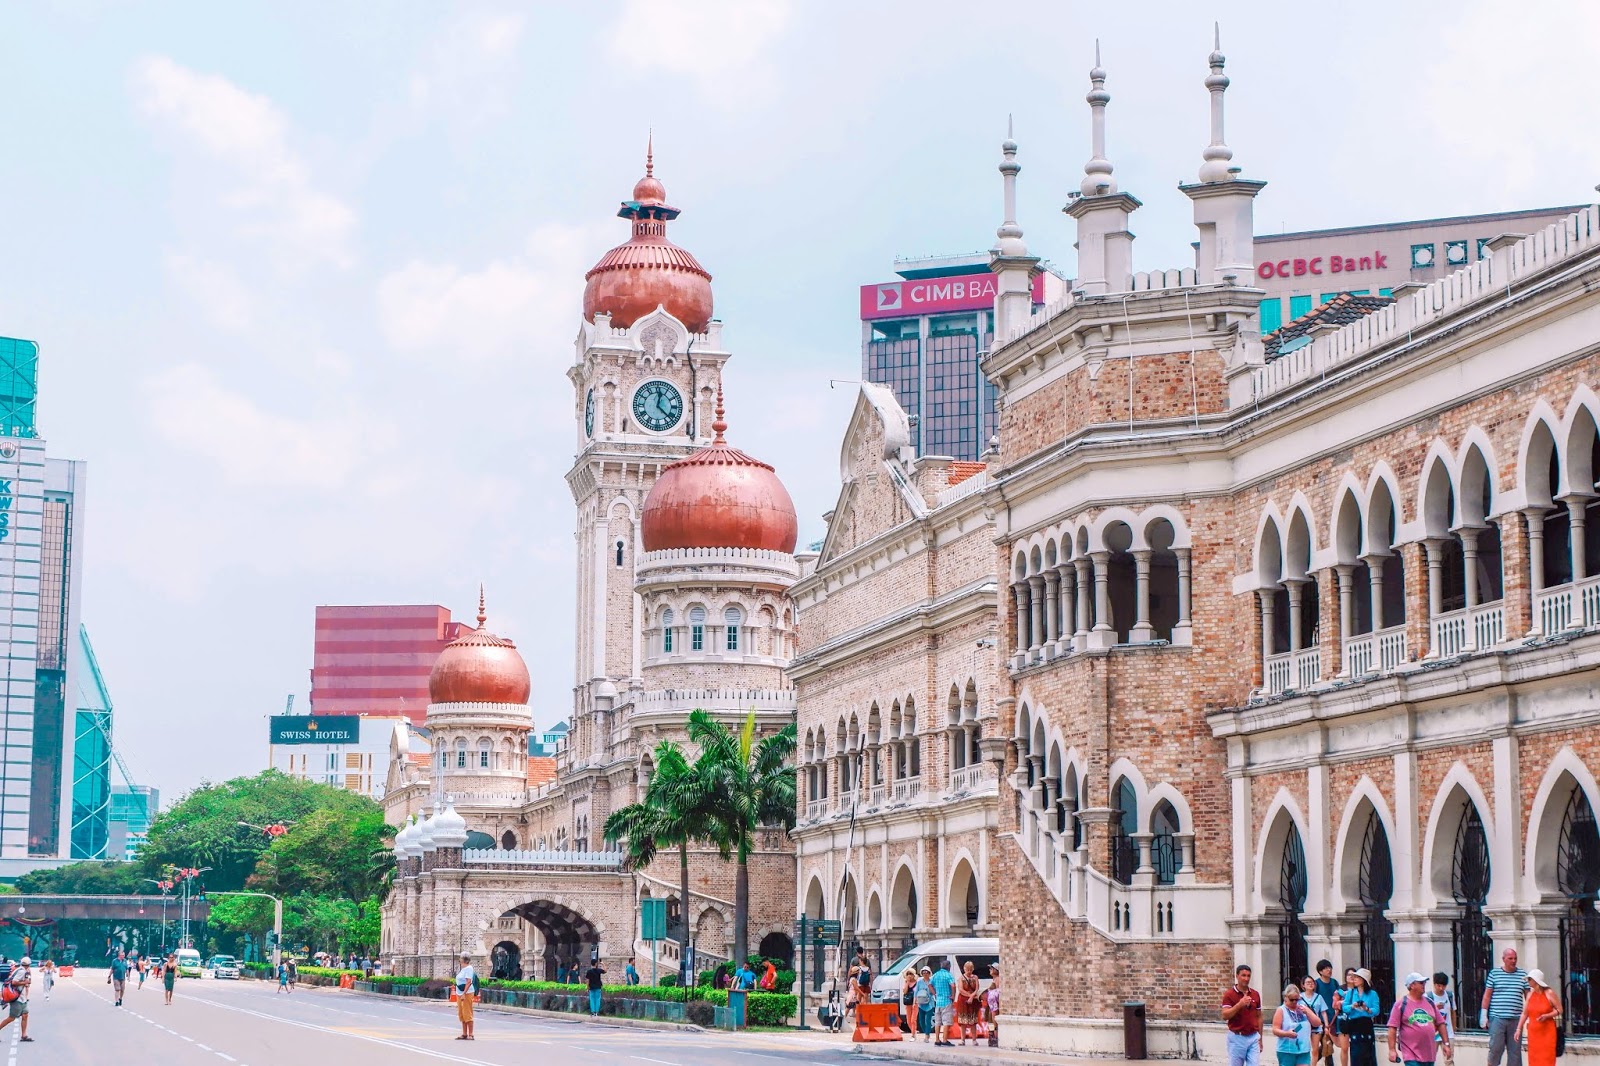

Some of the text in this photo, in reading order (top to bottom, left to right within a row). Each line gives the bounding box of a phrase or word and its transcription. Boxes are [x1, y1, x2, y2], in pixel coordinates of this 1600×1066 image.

[1258, 250, 1387, 279] OCBC Bank
[911, 280, 996, 302] CIMB BA
[280, 731, 350, 739] SWISS HOTEL
